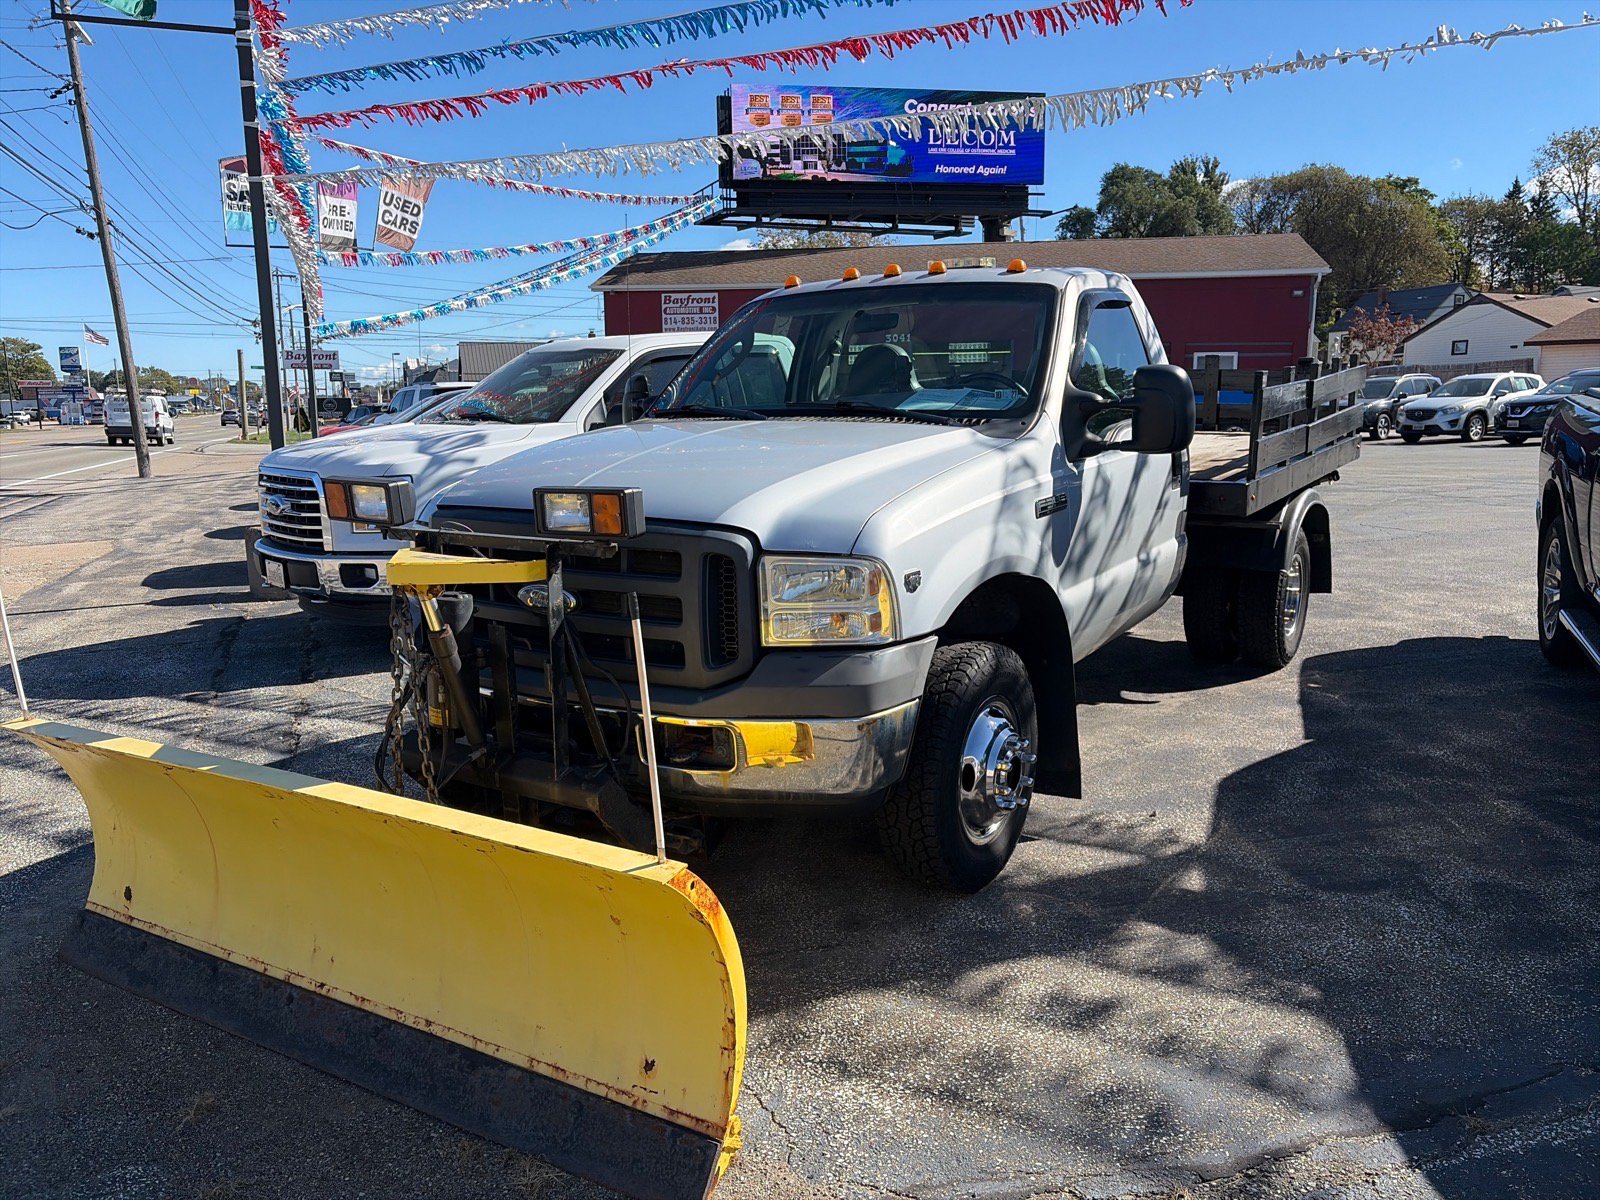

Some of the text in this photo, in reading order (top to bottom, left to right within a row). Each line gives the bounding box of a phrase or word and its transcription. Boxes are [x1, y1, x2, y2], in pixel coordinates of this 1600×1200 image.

[749, 95, 769, 103] BEST
[781, 96, 801, 104] BEST
[935, 164, 1008, 177] Honored Again!
[382, 190, 422, 218] USED
[321, 216, 354, 232] OWNED
[381, 209, 420, 235] CARS
[663, 294, 717, 306] Bayfront
[702, 306, 715, 314] INC.
[663, 316, 718, 326] 814-835-3318
[885, 333, 911, 343] 3041
[285, 350, 337, 362] Bayront
